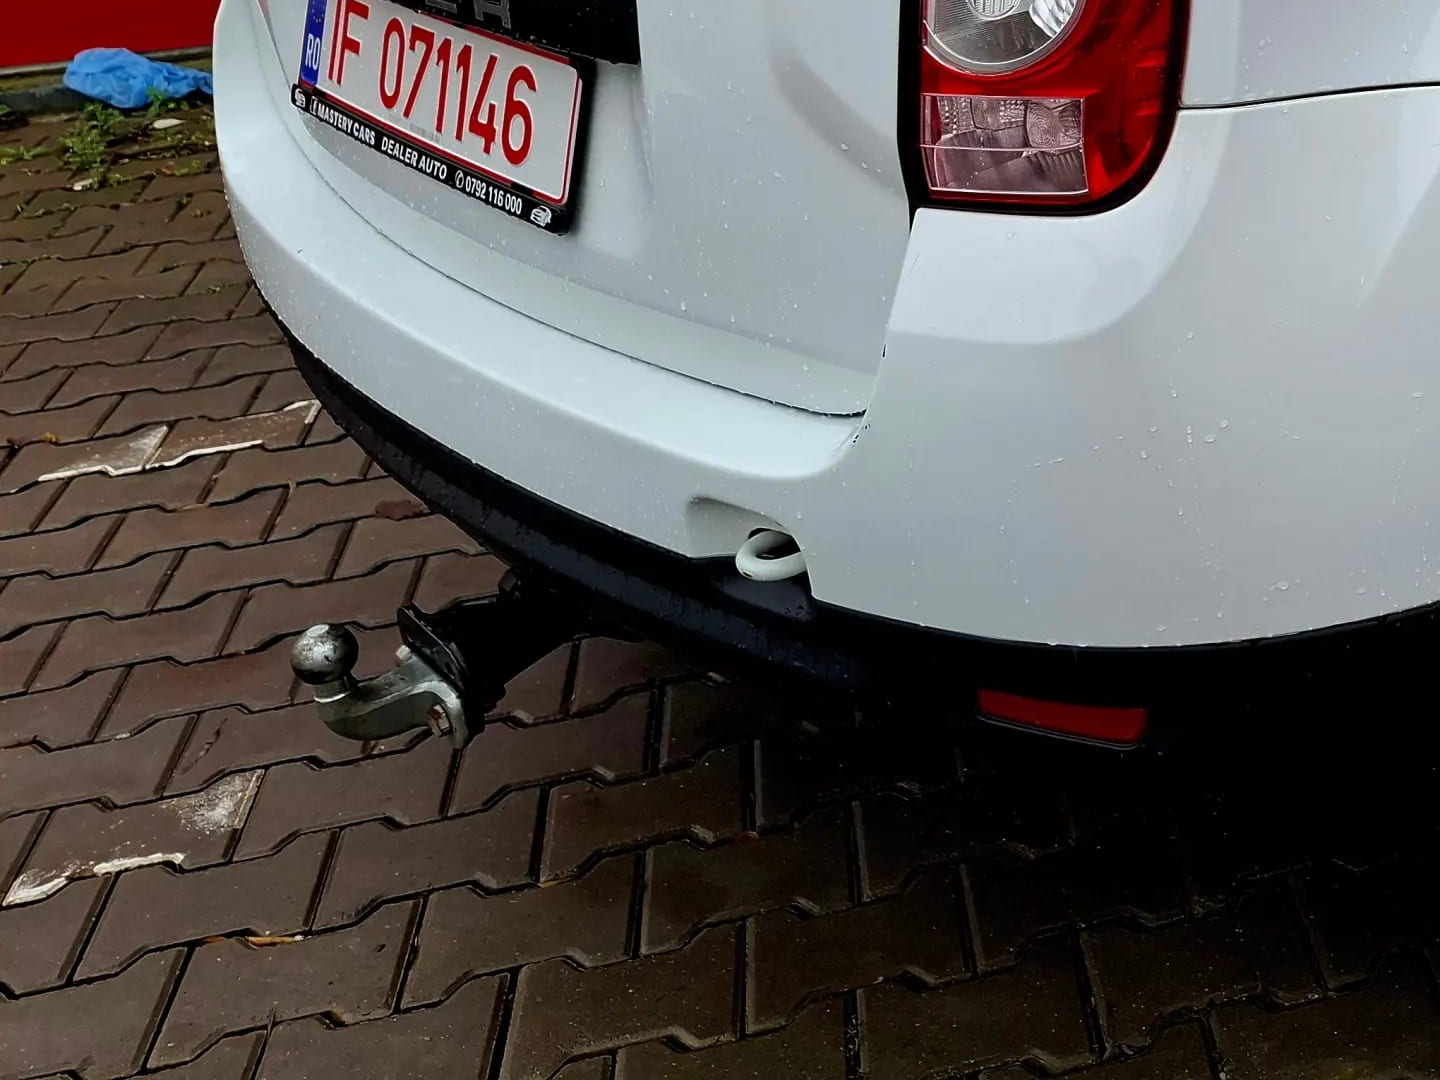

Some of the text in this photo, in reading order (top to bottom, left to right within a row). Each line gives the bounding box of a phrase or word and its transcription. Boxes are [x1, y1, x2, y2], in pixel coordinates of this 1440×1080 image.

[305, 32, 321, 71] RO
[378, 17, 538, 166] 071146
[317, 104, 353, 130] MASTERY
[353, 123, 375, 145] CARS
[381, 136, 417, 166] DEALER
[418, 157, 447, 180] AUTO
[465, 175, 487, 199] 0792
[488, 187, 504, 206] 116
[504, 195, 522, 215] 000
